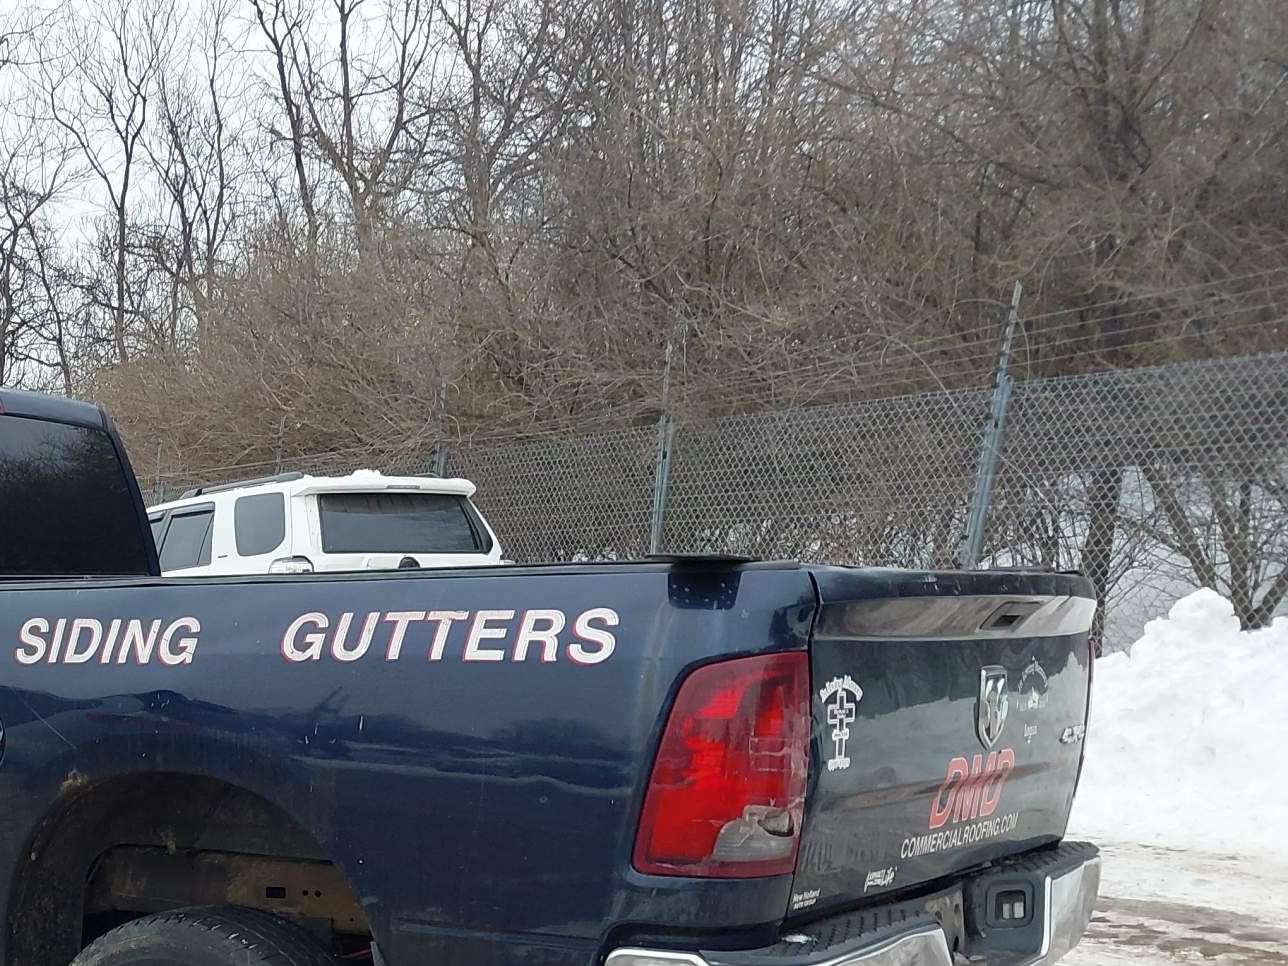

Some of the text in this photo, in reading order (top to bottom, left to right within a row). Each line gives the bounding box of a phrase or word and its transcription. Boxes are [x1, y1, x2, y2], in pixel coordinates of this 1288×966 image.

[15, 616, 202, 665] SIDING
[281, 607, 620, 665] GUTTERS
[929, 748, 1015, 829] DMD
[900, 811, 1019, 859] COMMERCIALROOFING.COM
